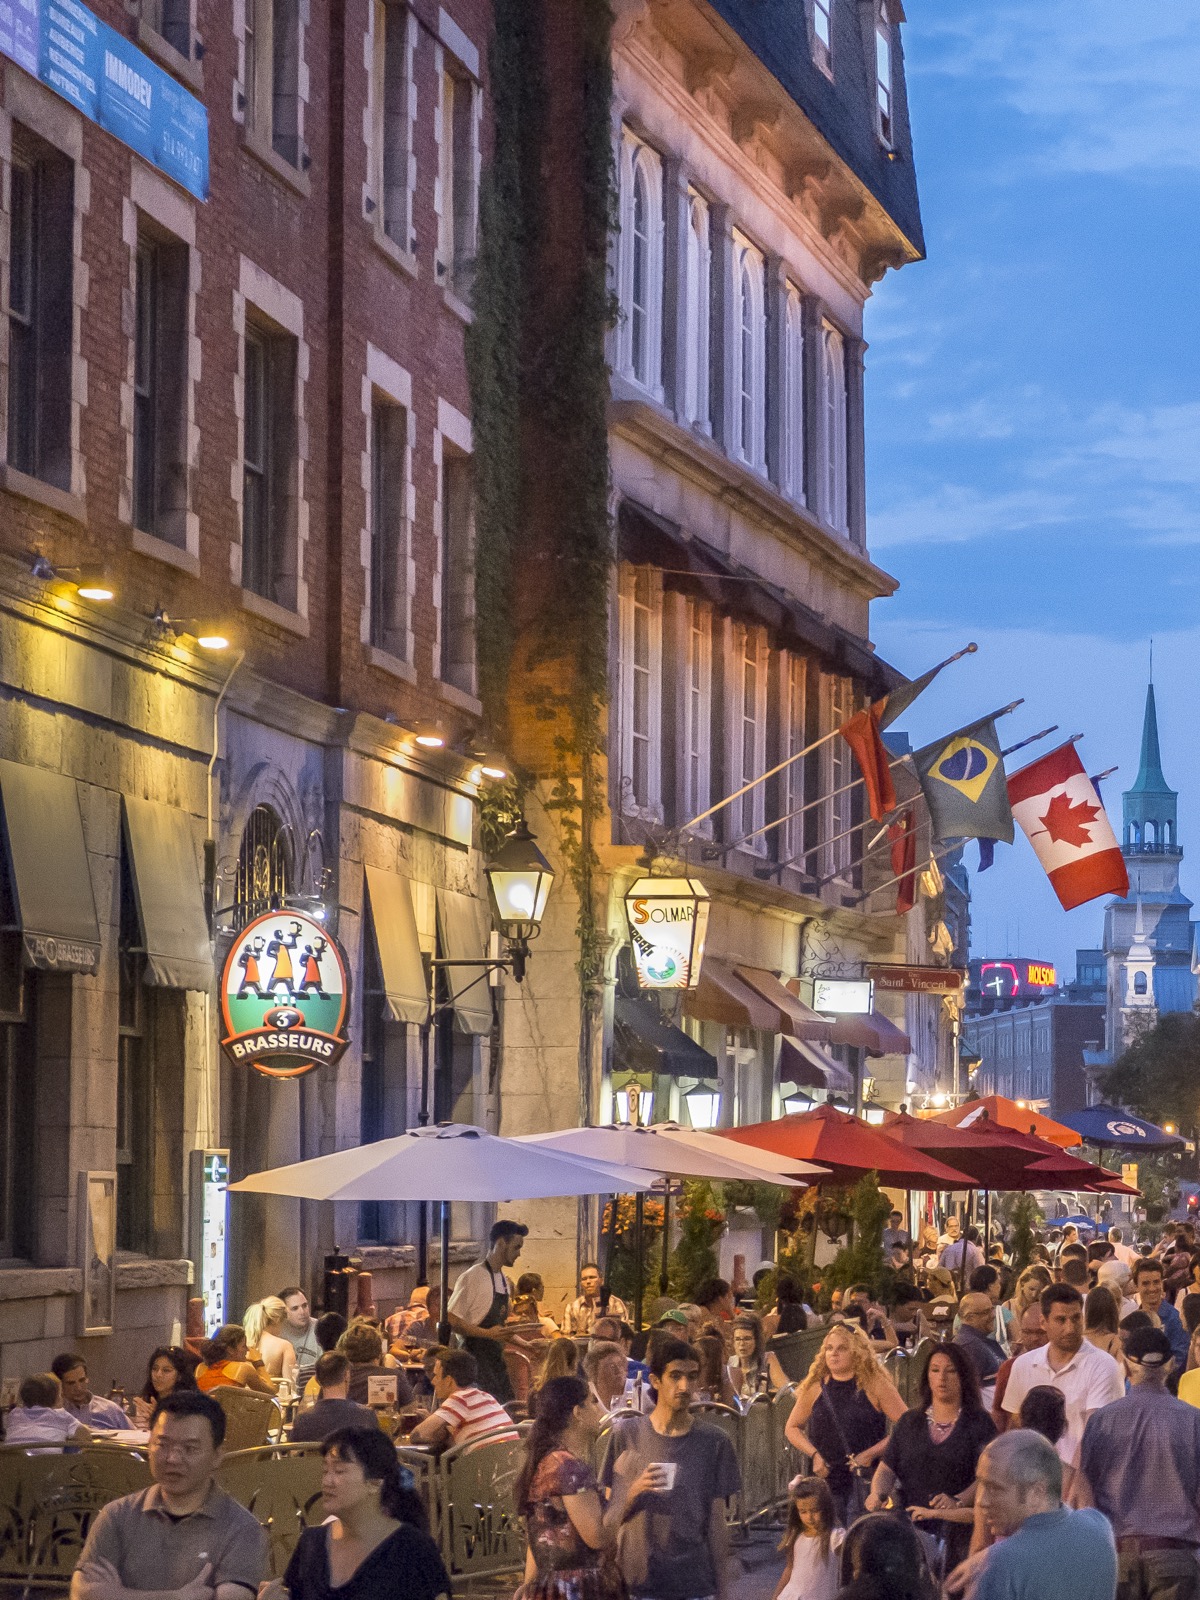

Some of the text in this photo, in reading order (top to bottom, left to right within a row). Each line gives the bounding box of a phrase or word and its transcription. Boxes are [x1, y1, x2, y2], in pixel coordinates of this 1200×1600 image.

[105, 49, 151, 109] IMMODEV
[633, 898, 694, 924] SOLMAR
[1028, 965, 1055, 985] MOLSON
[276, 1011, 290, 1027] 3
[232, 1034, 334, 1058] BRASSEURS
